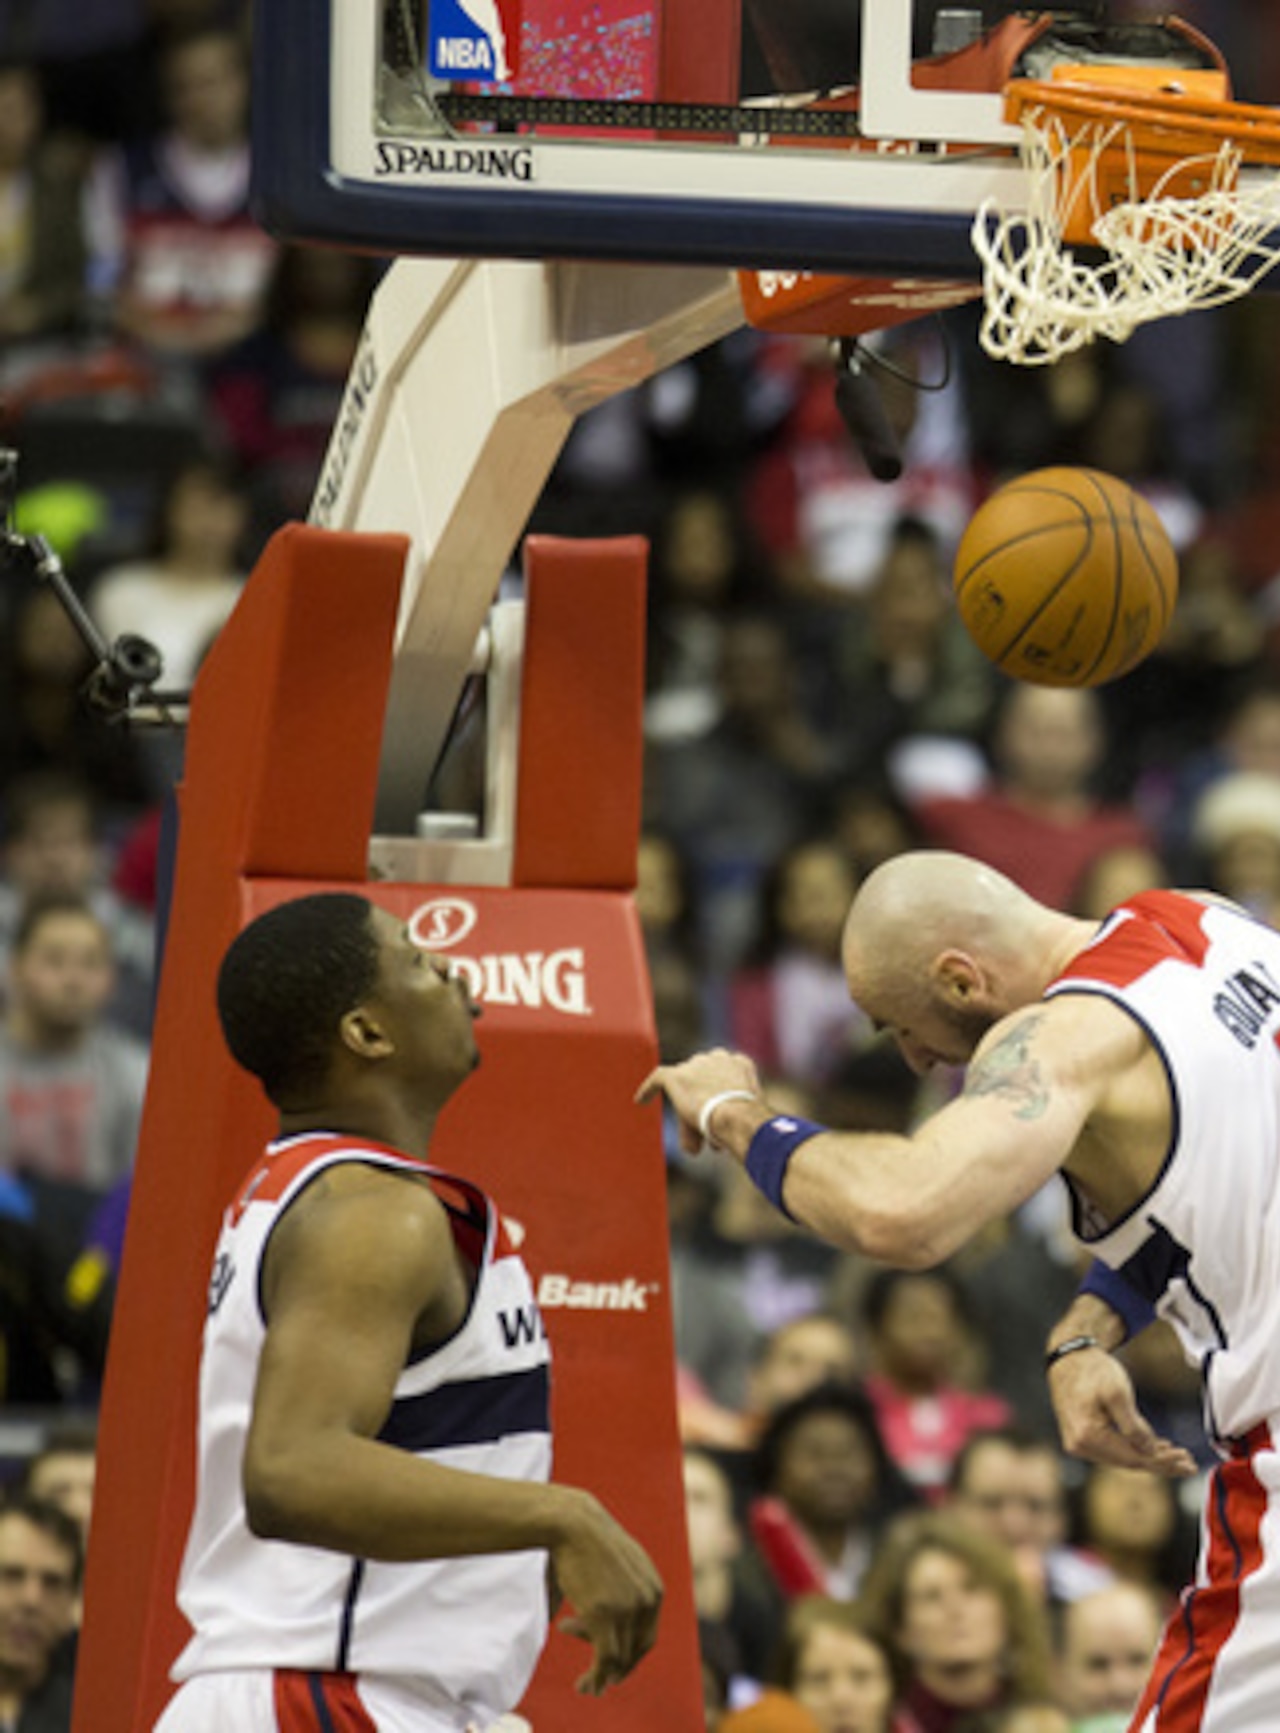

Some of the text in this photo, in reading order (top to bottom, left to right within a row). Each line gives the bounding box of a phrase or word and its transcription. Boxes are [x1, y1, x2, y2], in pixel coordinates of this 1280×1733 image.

[437, 37, 492, 69] NBA
[374, 141, 533, 181] SPALDING
[451, 949, 584, 1014] DING
[537, 1274, 648, 1310] Bank
